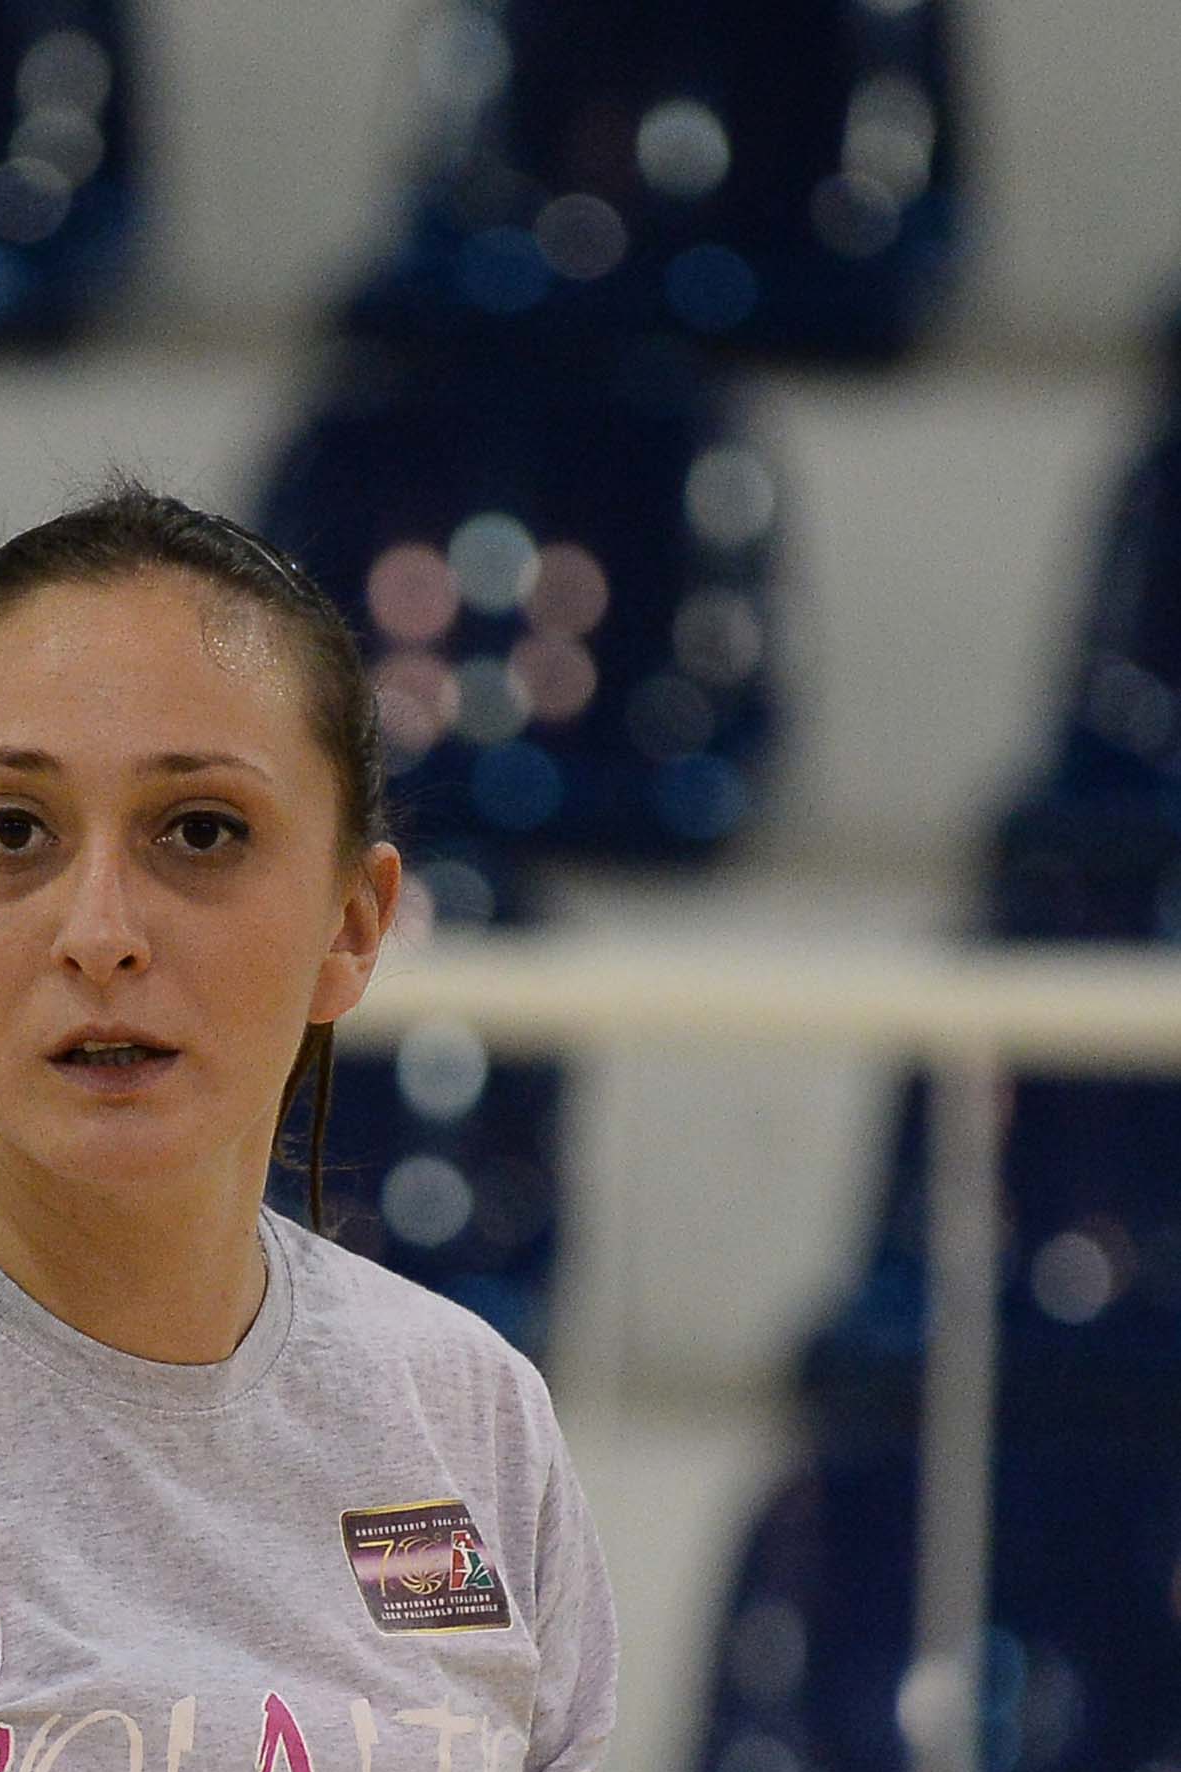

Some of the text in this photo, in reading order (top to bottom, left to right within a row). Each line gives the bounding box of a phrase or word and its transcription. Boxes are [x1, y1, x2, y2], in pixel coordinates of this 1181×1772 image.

[383, 1594, 491, 1610] CAMPIONATO ITALIANO
[404, 1607, 453, 1620] PALLAVOLO
